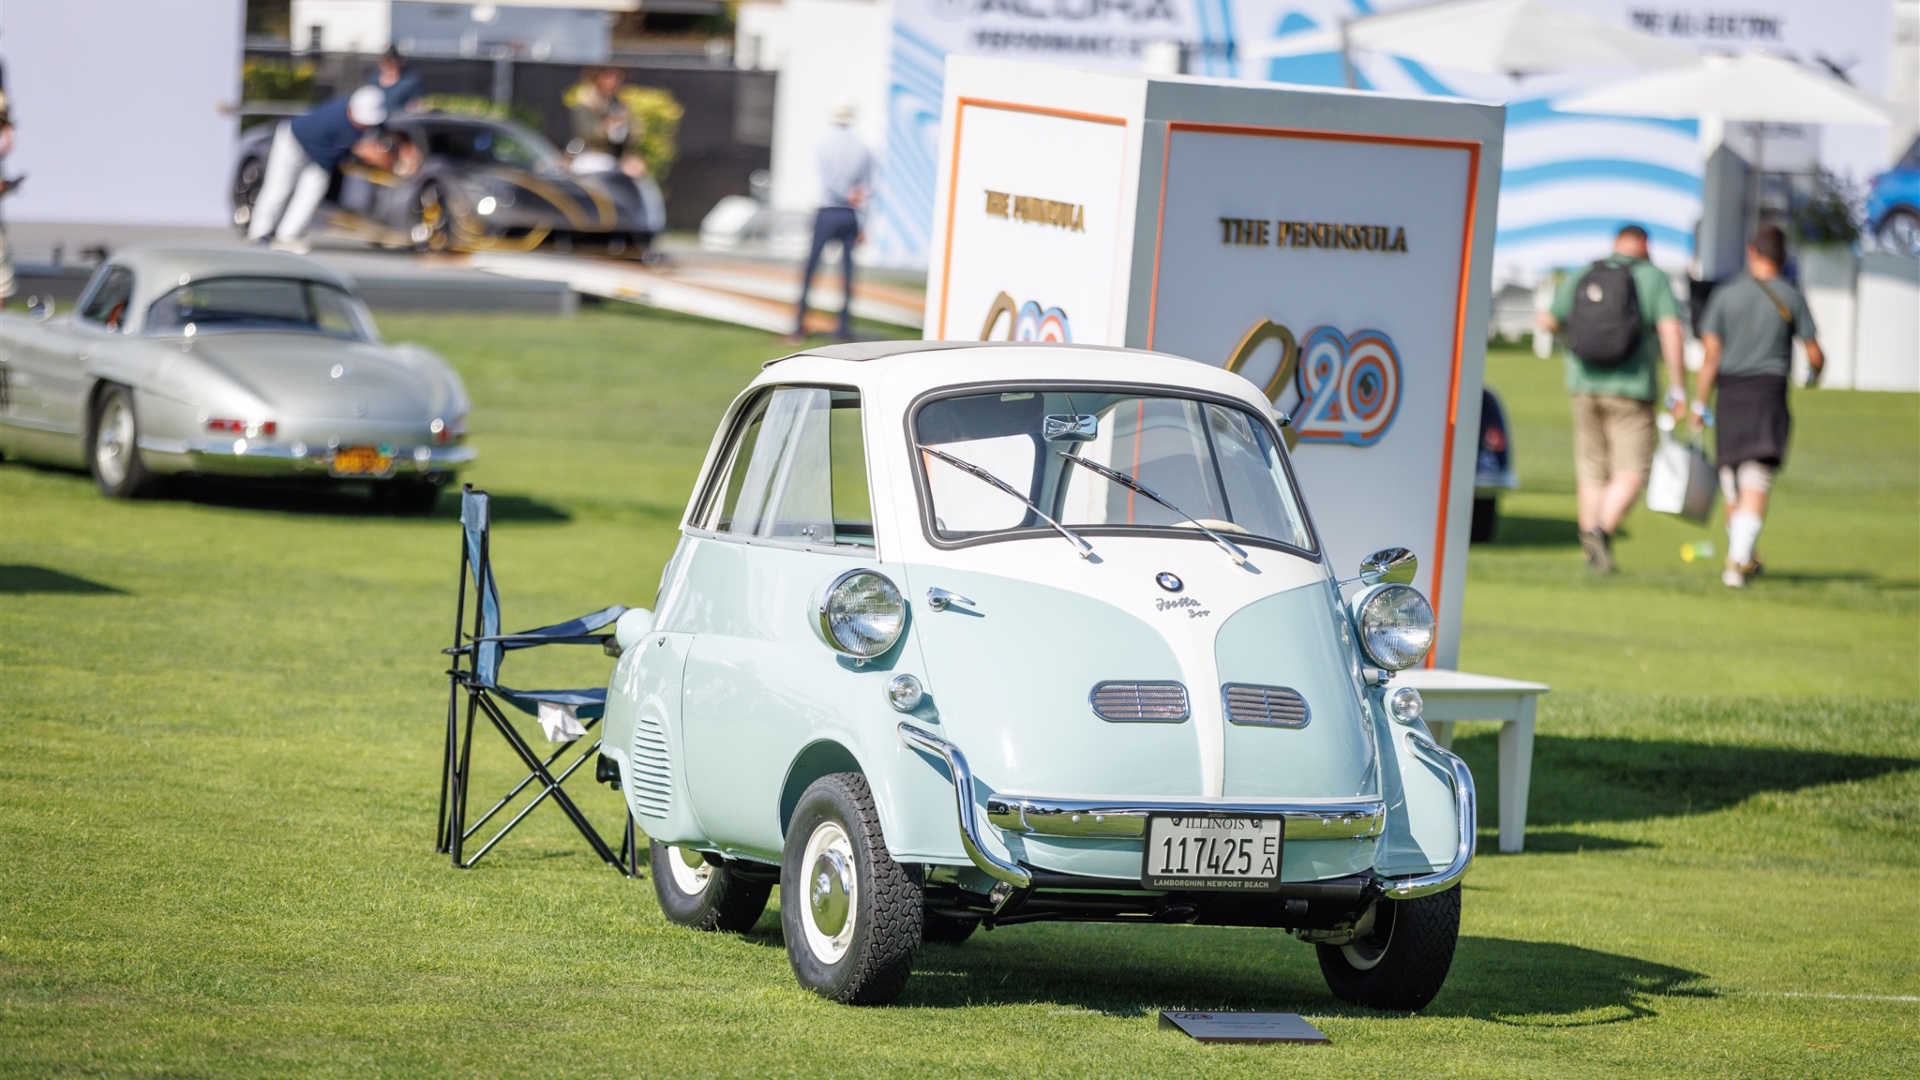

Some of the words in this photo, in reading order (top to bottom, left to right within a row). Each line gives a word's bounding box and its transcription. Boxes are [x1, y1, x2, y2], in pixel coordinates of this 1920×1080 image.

[1219, 217, 1270, 246] THE
[1277, 220, 1408, 254] PENINSULA
[1185, 818, 1245, 830] ILLINOIS
[1160, 836, 1253, 875] 117425
[1153, 879, 1205, 887] LAMBORGHINI
[1206, 880, 1242, 888] NEWPORT
[1244, 881, 1269, 889] BEACH
